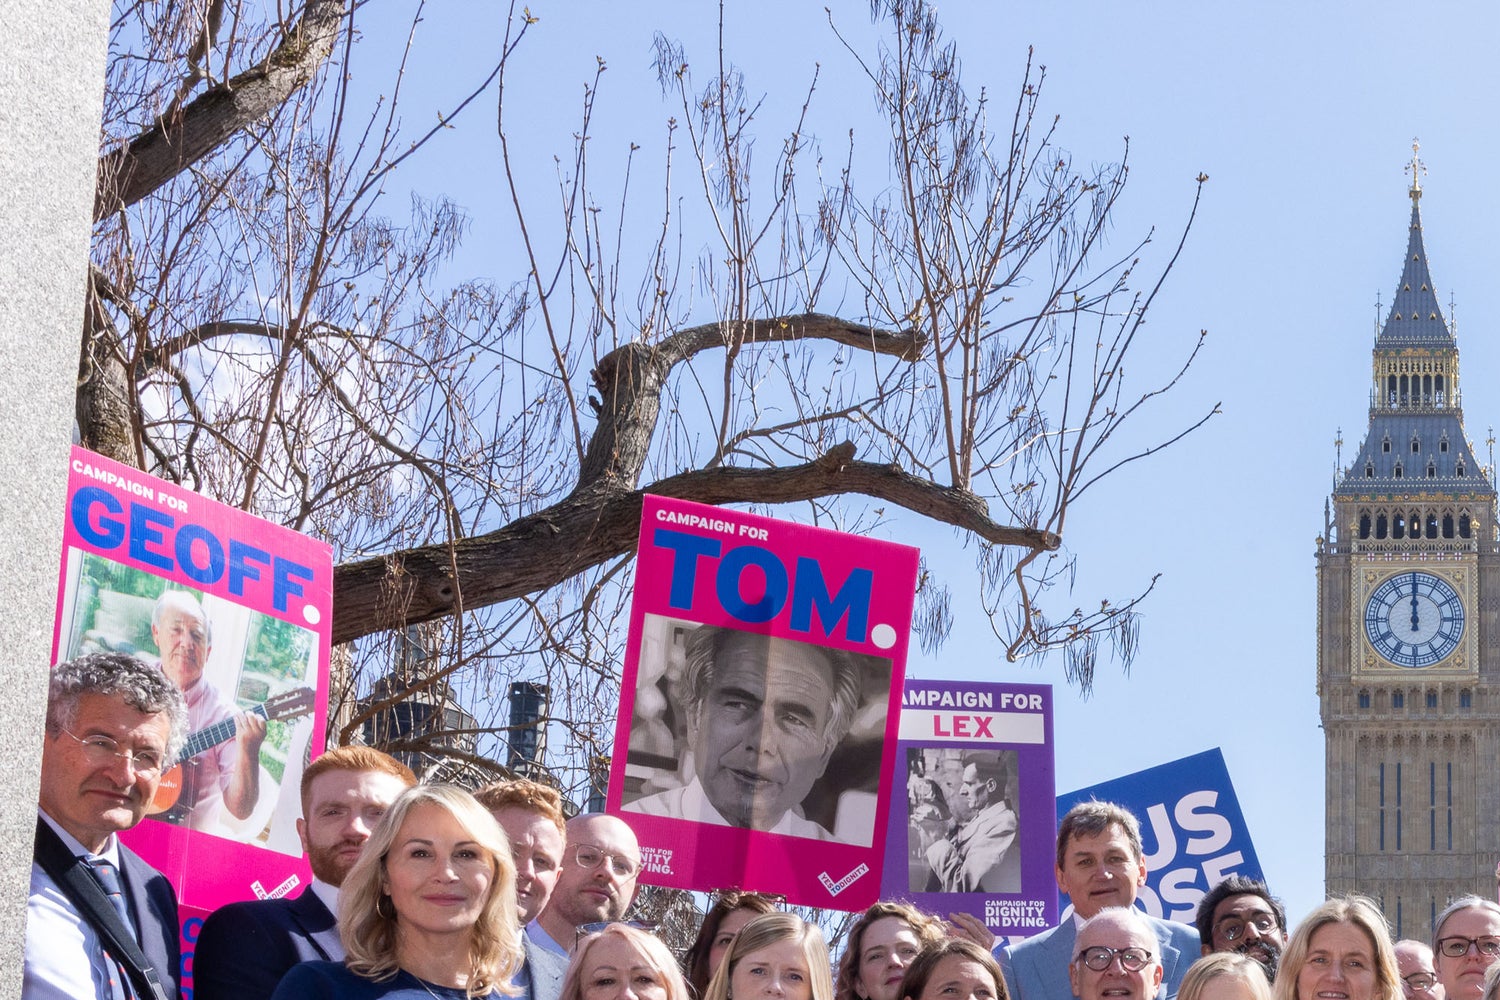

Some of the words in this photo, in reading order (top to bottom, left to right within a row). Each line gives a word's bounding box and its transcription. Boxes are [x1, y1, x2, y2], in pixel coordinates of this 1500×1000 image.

[72, 459, 154, 501] CAMPAIGN
[158, 491, 188, 513] FOR
[656, 509, 735, 535] CAMPAIGN
[739, 524, 769, 542] FOR
[71, 486, 321, 625] GEOFF.
[653, 528, 897, 649] TOM.
[902, 689, 993, 708] MPAIGN
[1001, 693, 1043, 710] FOR
[934, 715, 994, 738] LEX
[640, 852, 672, 865] NITY
[641, 862, 675, 875] YING.
[985, 907, 1045, 917] DIGNITY
[985, 917, 1000, 927] IN
[1002, 917, 1050, 927] DYING.
